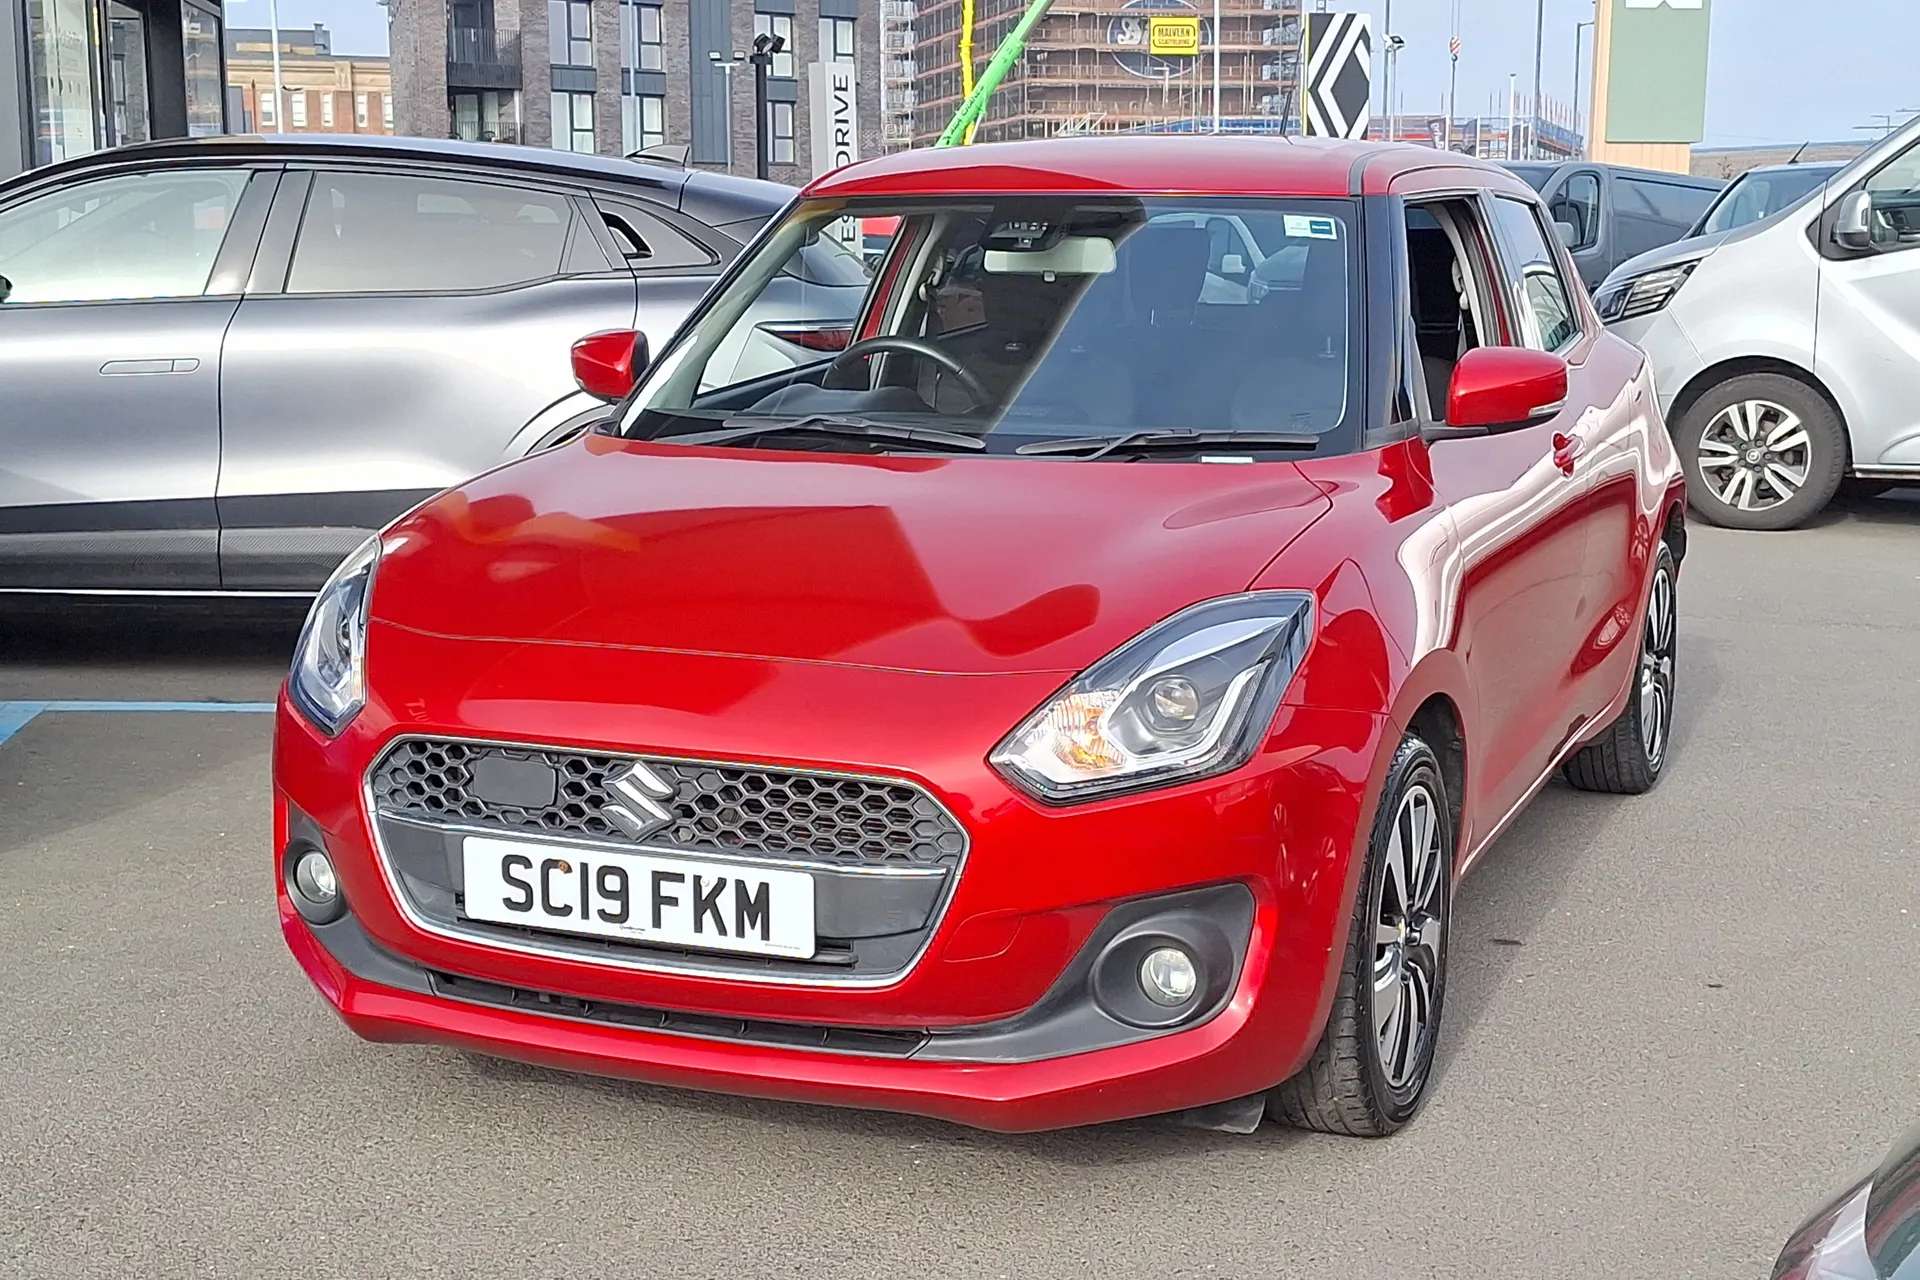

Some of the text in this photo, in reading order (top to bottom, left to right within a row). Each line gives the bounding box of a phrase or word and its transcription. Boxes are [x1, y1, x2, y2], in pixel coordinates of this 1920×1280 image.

[833, 74, 850, 169] DRIVE
[501, 854, 770, 941] SC19 FKM
